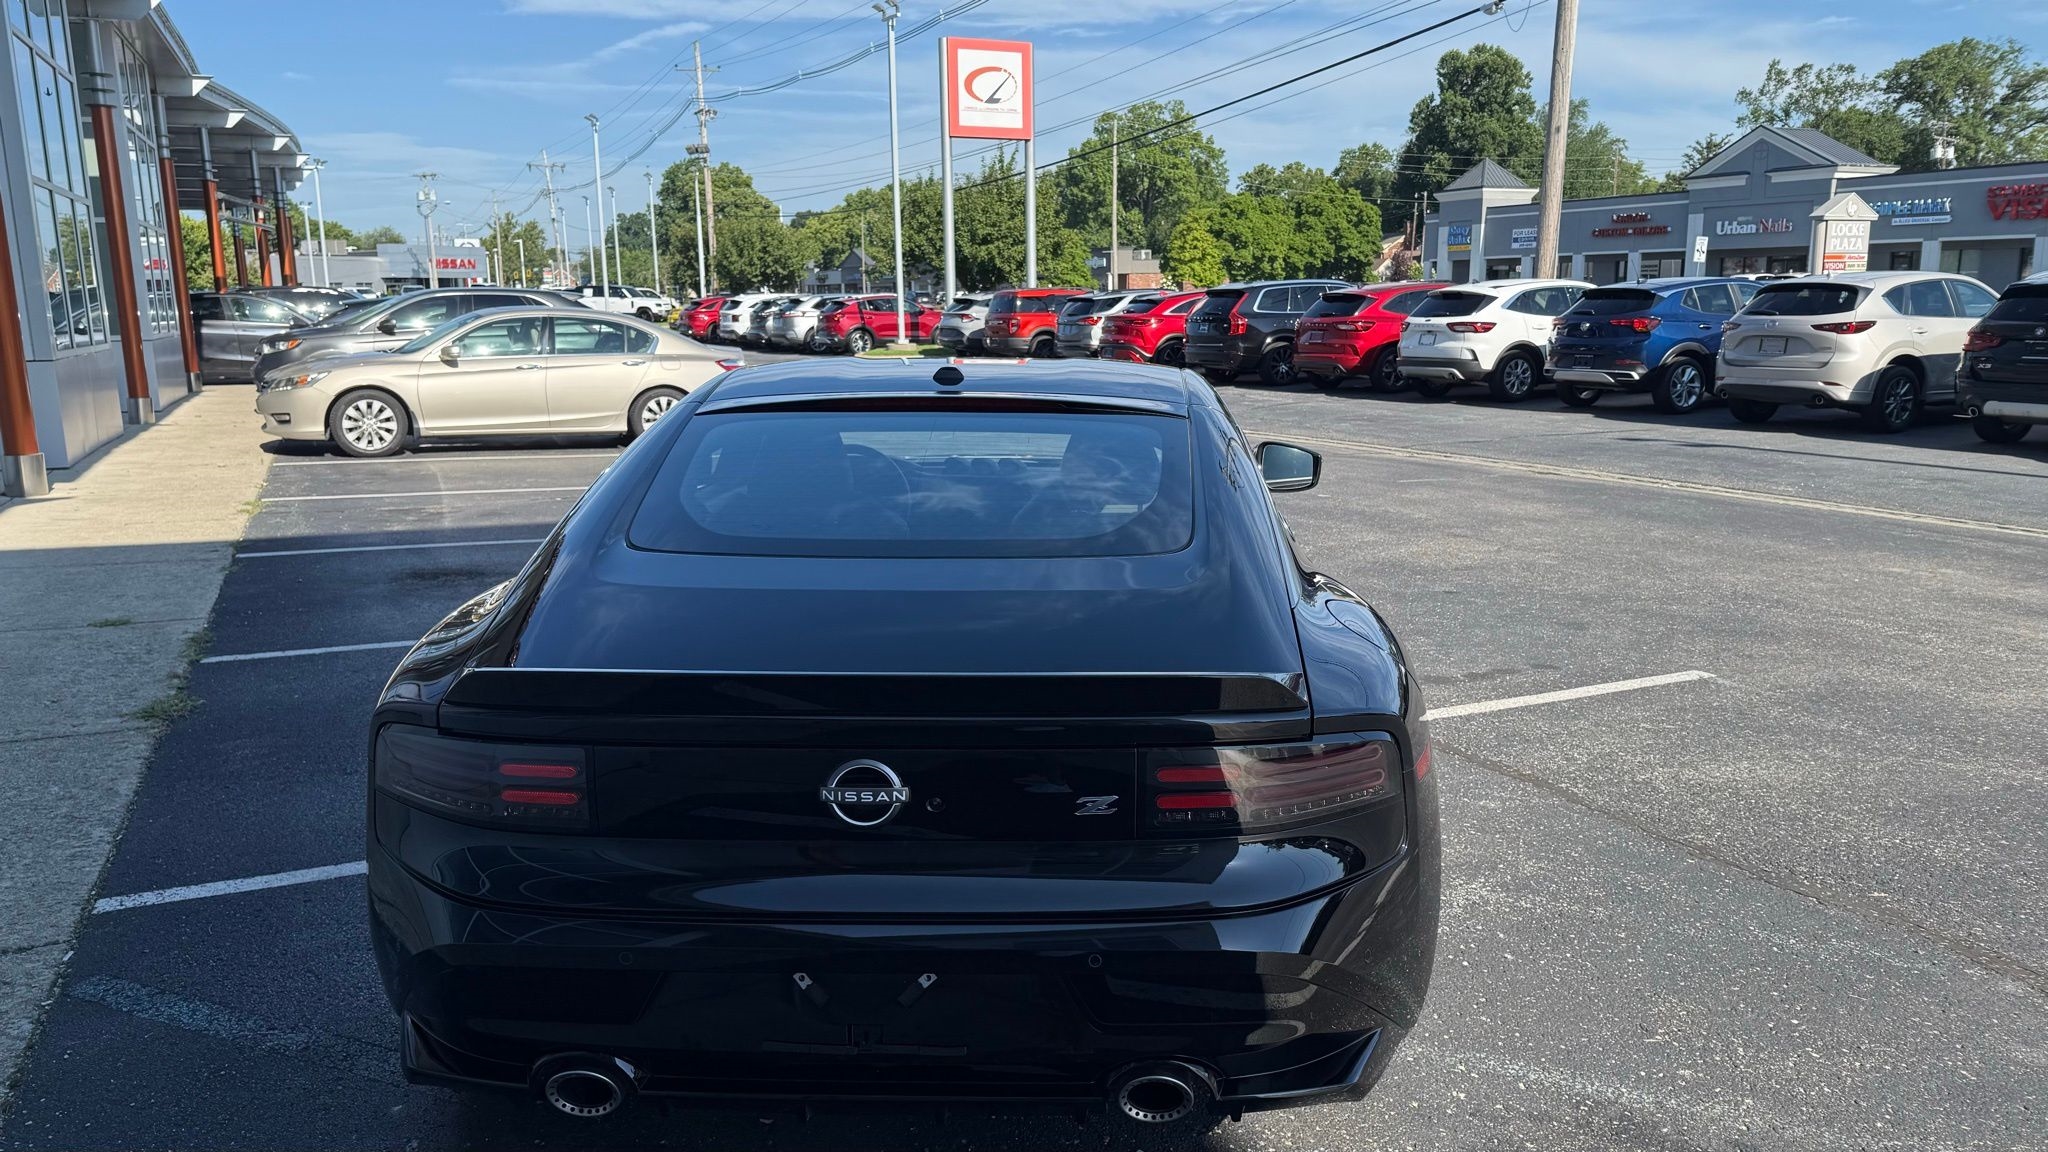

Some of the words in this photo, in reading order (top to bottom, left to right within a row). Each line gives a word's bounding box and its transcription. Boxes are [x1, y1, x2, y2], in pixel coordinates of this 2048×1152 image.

[1716, 220, 1757, 235] Urban
[1759, 217, 1793, 233] Nails
[1831, 223, 1865, 236] LOCKE
[1830, 237, 1863, 250] PLAZA
[436, 258, 476, 270] ISSAN
[1825, 262, 1844, 270] VISION
[822, 789, 907, 802] NISSAN
[1074, 795, 1119, 815] Z
